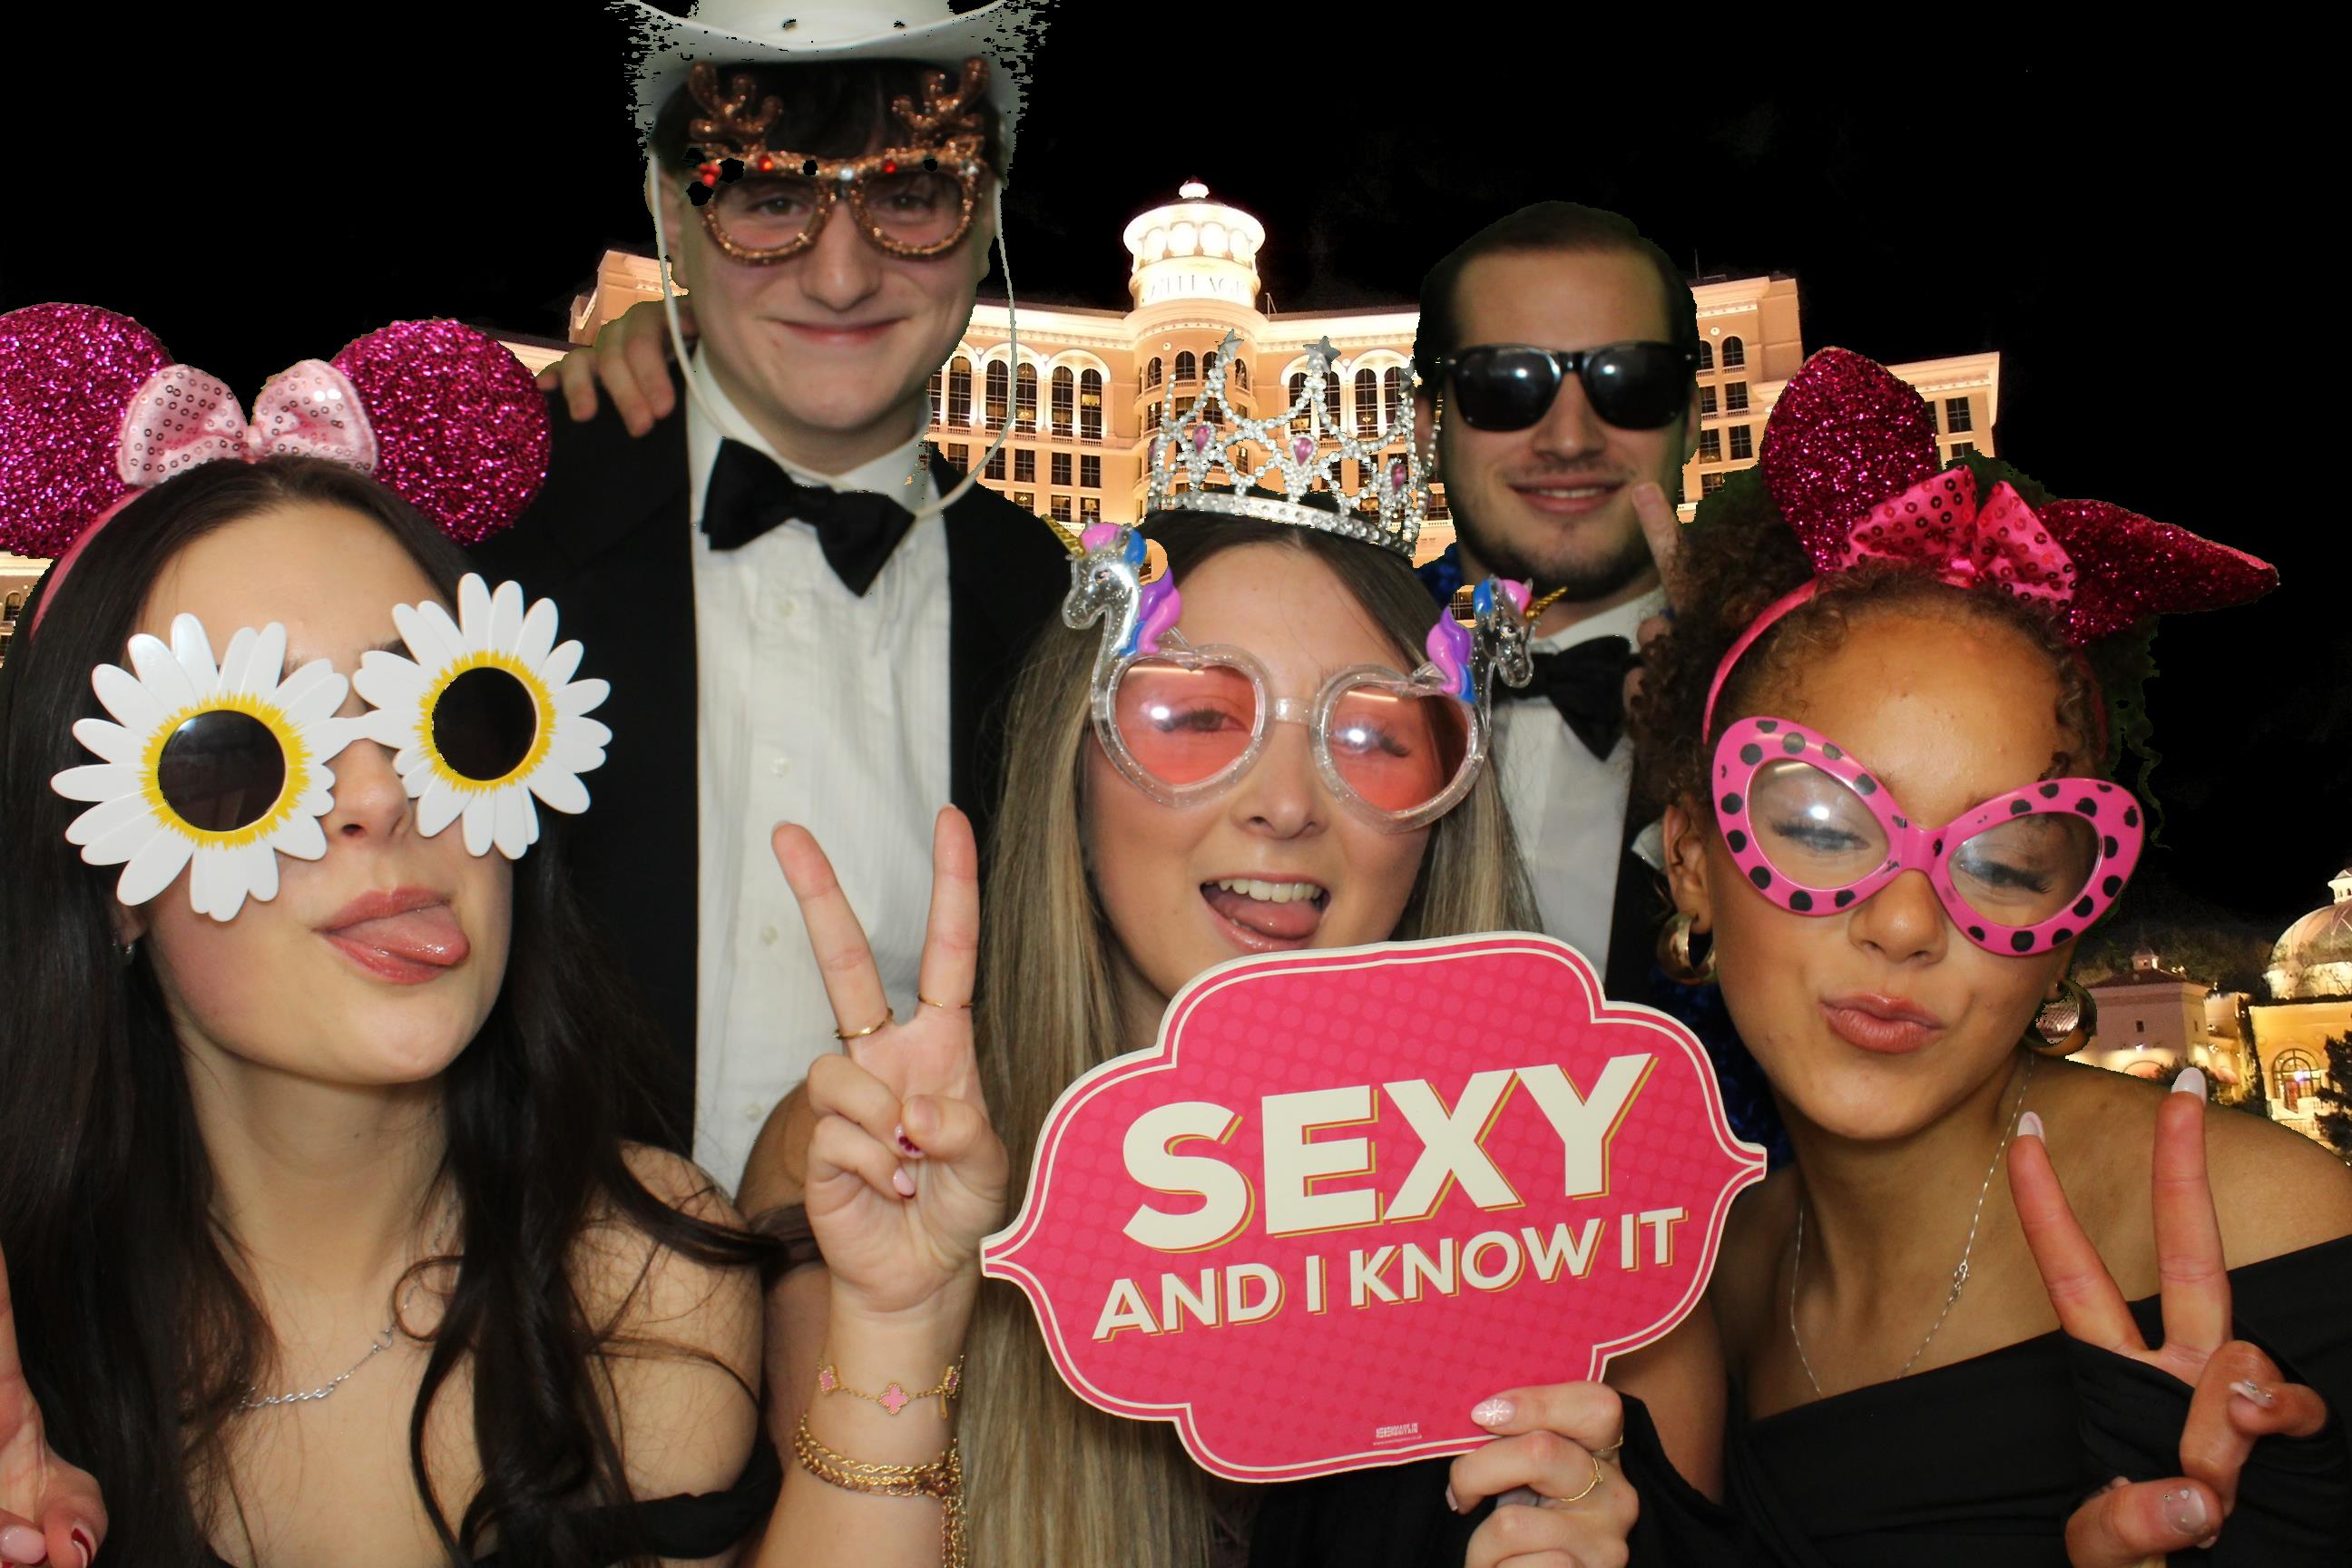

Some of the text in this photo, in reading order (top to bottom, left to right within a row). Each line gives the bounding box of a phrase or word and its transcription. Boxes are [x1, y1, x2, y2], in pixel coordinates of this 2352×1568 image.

[1122, 1054, 1659, 1253] SEXY
[1093, 1207, 1687, 1342] AND I KNOW IT
